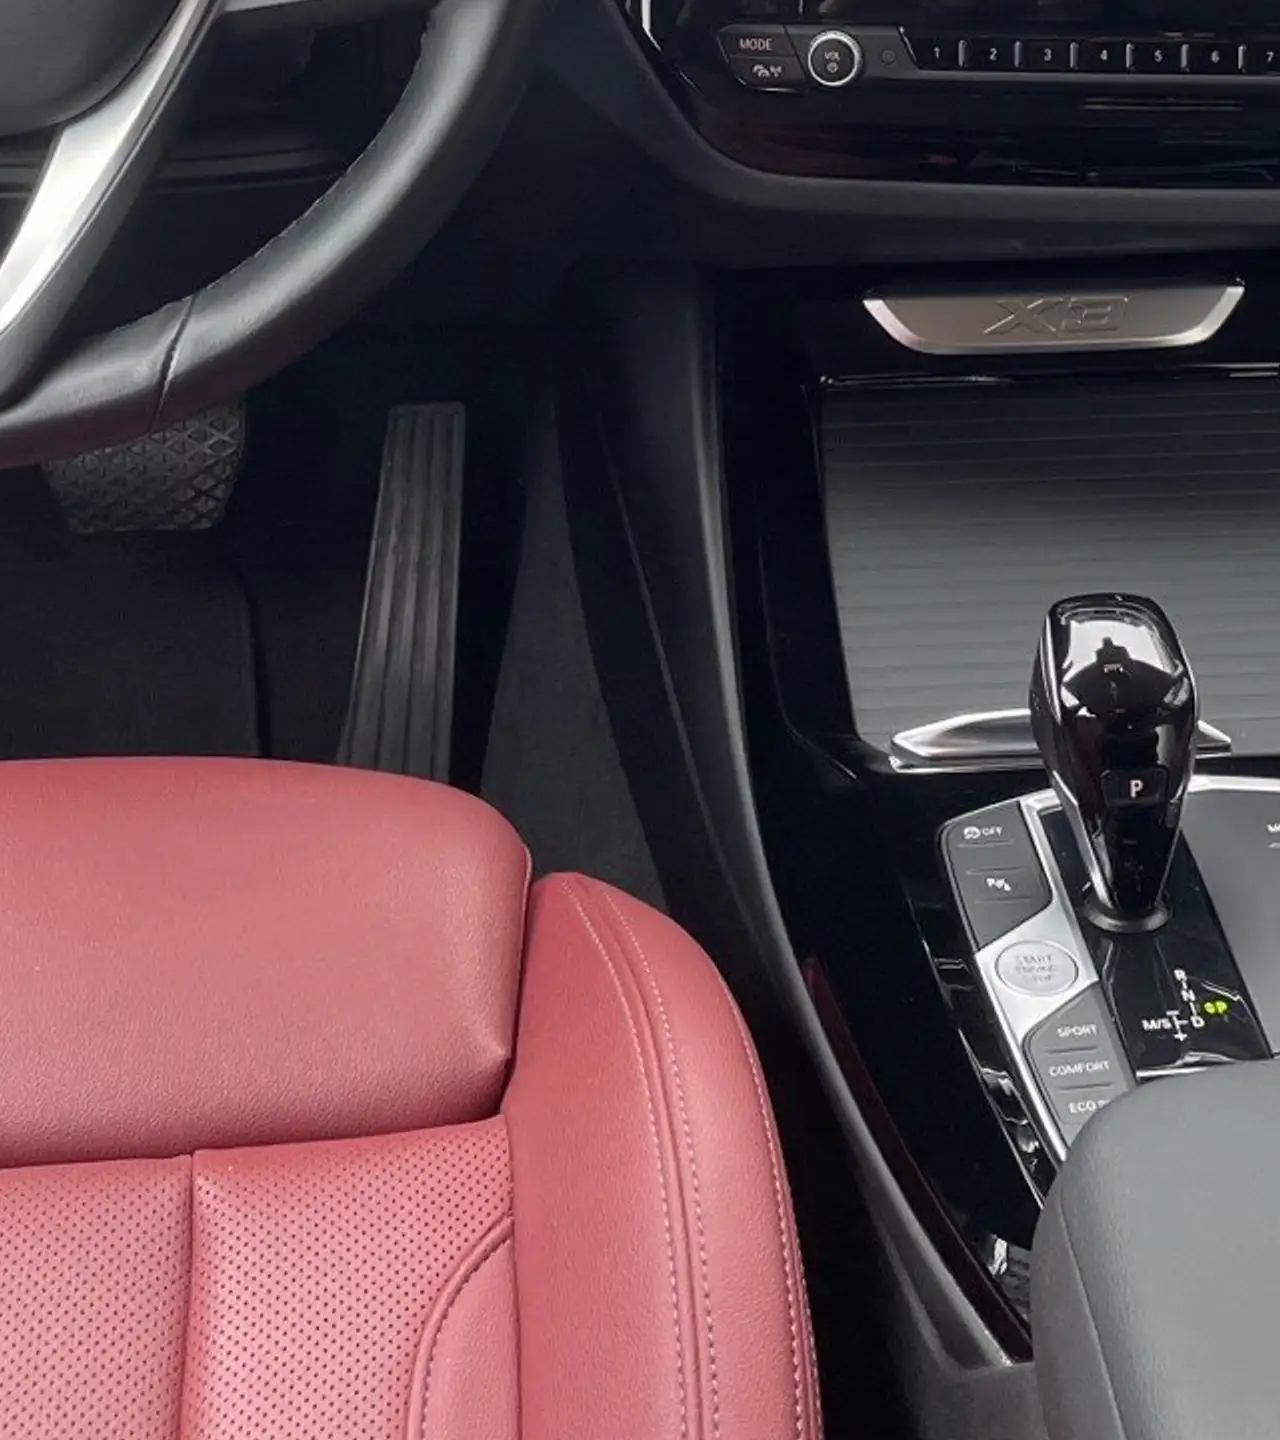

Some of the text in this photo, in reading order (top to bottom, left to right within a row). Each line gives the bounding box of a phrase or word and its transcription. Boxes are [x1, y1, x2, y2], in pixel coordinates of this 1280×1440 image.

[739, 37, 773, 52] MODE
[933, 47, 941, 59] 1
[989, 48, 998, 61] 2
[1043, 48, 1053, 62] 3
[1099, 50, 1109, 62] 4
[1154, 50, 1163, 62] 5
[1211, 51, 1220, 63] 6
[1265, 51, 1275, 64] 7
[1130, 779, 1143, 798] P
[1142, 1017, 1172, 1031] M/S
[1190, 1015, 1205, 1028] D
[1057, 1023, 1098, 1038] SPORT
[1048, 1060, 1110, 1077] COMFORT
[1068, 1100, 1097, 1114] ECO
